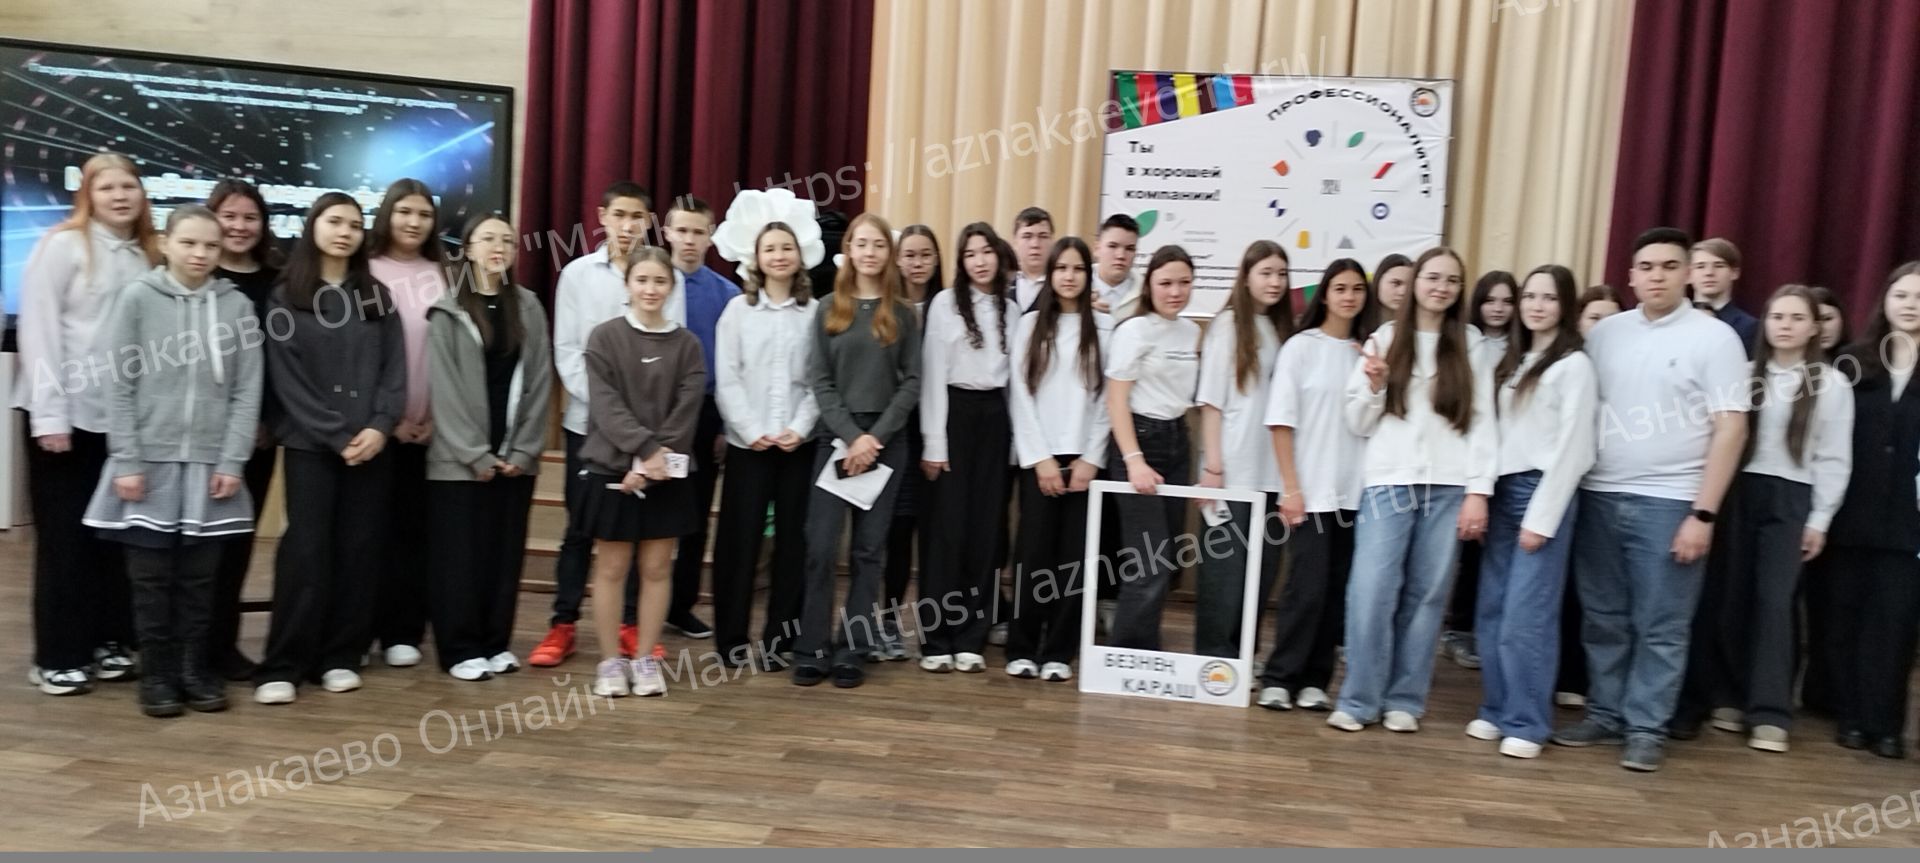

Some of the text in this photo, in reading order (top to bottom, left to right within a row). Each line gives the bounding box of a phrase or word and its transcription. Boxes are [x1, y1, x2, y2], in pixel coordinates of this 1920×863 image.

[1130, 141, 1154, 154] Ты
[1267, 87, 1433, 198] ПРОФЕССИОНАЛИТЕТ
[1127, 165, 1222, 180] в хорошей
[1125, 189, 1220, 201] компании!
[1122, 678, 1197, 698] КАРАШ
